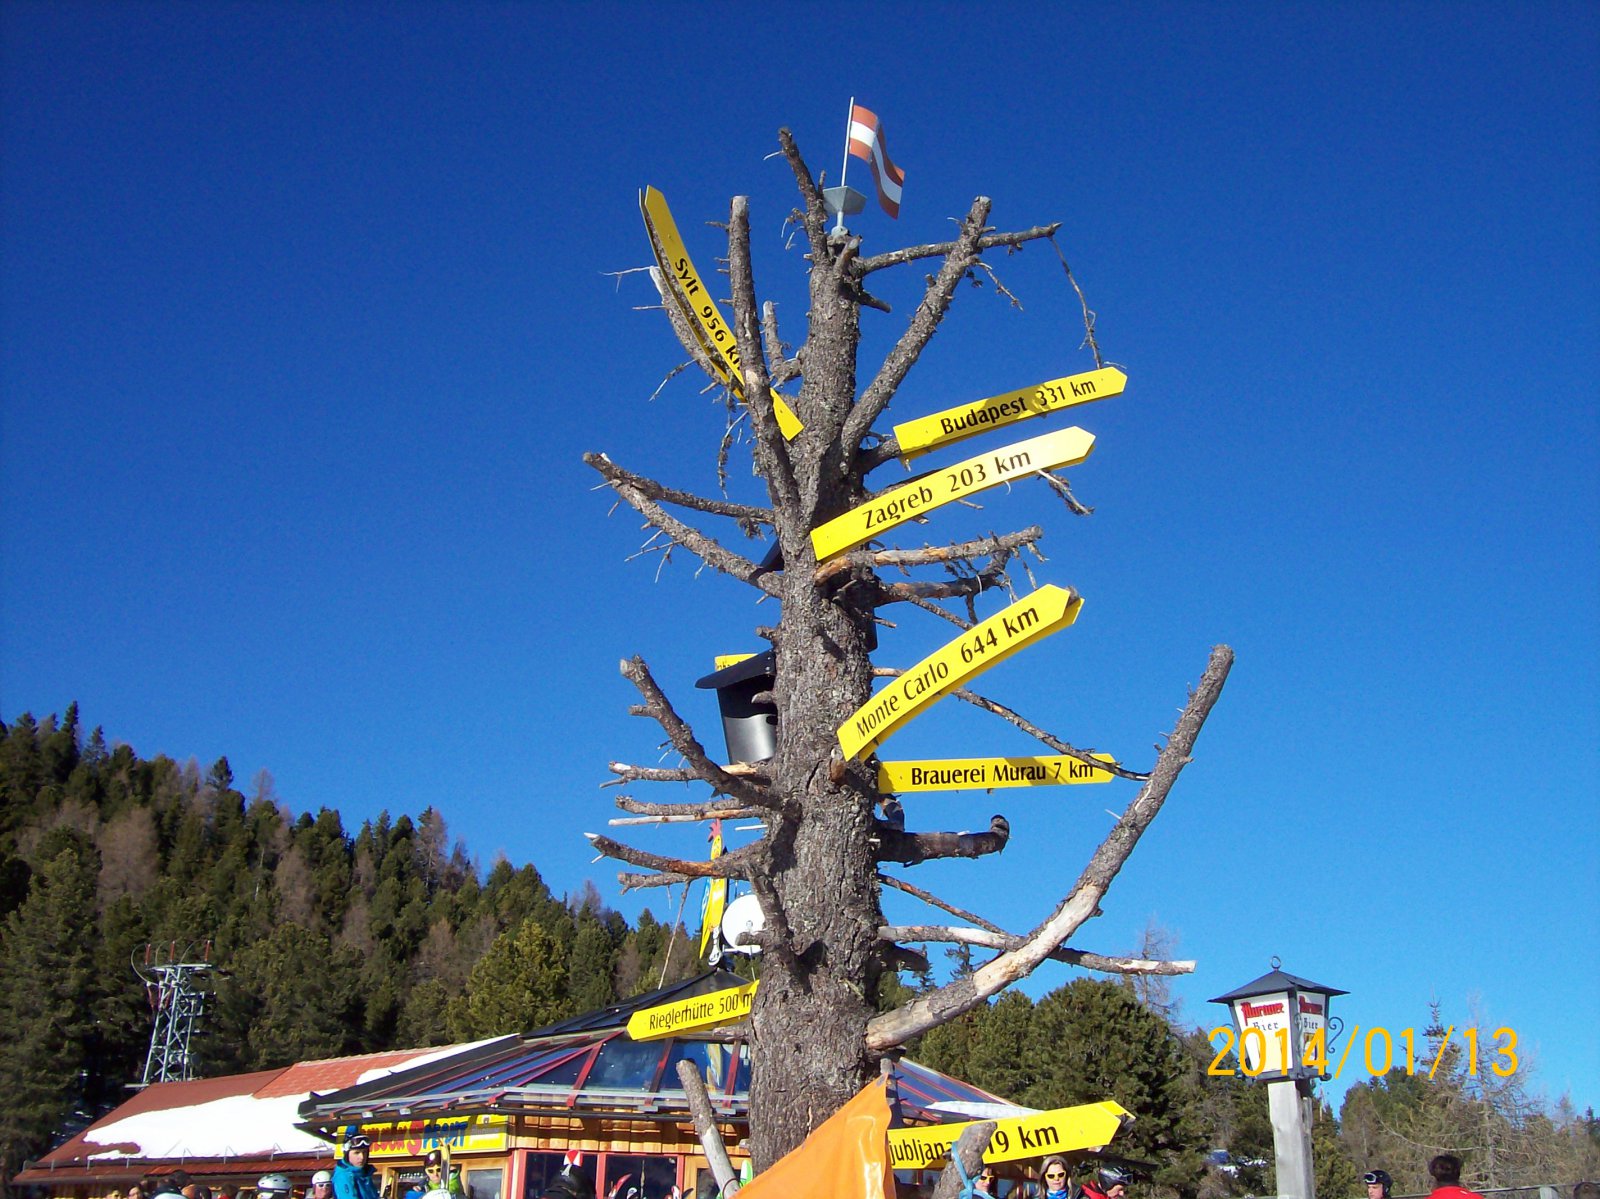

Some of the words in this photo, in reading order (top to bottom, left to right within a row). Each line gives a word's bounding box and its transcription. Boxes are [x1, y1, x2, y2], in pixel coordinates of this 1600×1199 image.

[675, 258, 699, 296] Sylt
[701, 305, 727, 342] 956
[940, 396, 1028, 435] Budapest
[1036, 386, 1066, 407] 331
[1070, 380, 1096, 397] km
[862, 486, 933, 530] Zagreb
[947, 464, 987, 493] 203
[995, 451, 1032, 475] km
[856, 694, 900, 741] Monte
[903, 661, 949, 701] Carlo
[960, 627, 998, 664] 644
[1002, 607, 1040, 638] km
[911, 765, 985, 786] Brauerei
[993, 764, 1046, 782] Murau
[1053, 762, 1062, 779] 7
[1069, 760, 1094, 779] km
[649, 1002, 715, 1031] Rieglerhütte
[719, 994, 739, 1015] 500
[742, 993, 753, 1009] m
[1253, 1018, 1279, 1032] Bier
[1017, 1125, 1060, 1150] km
